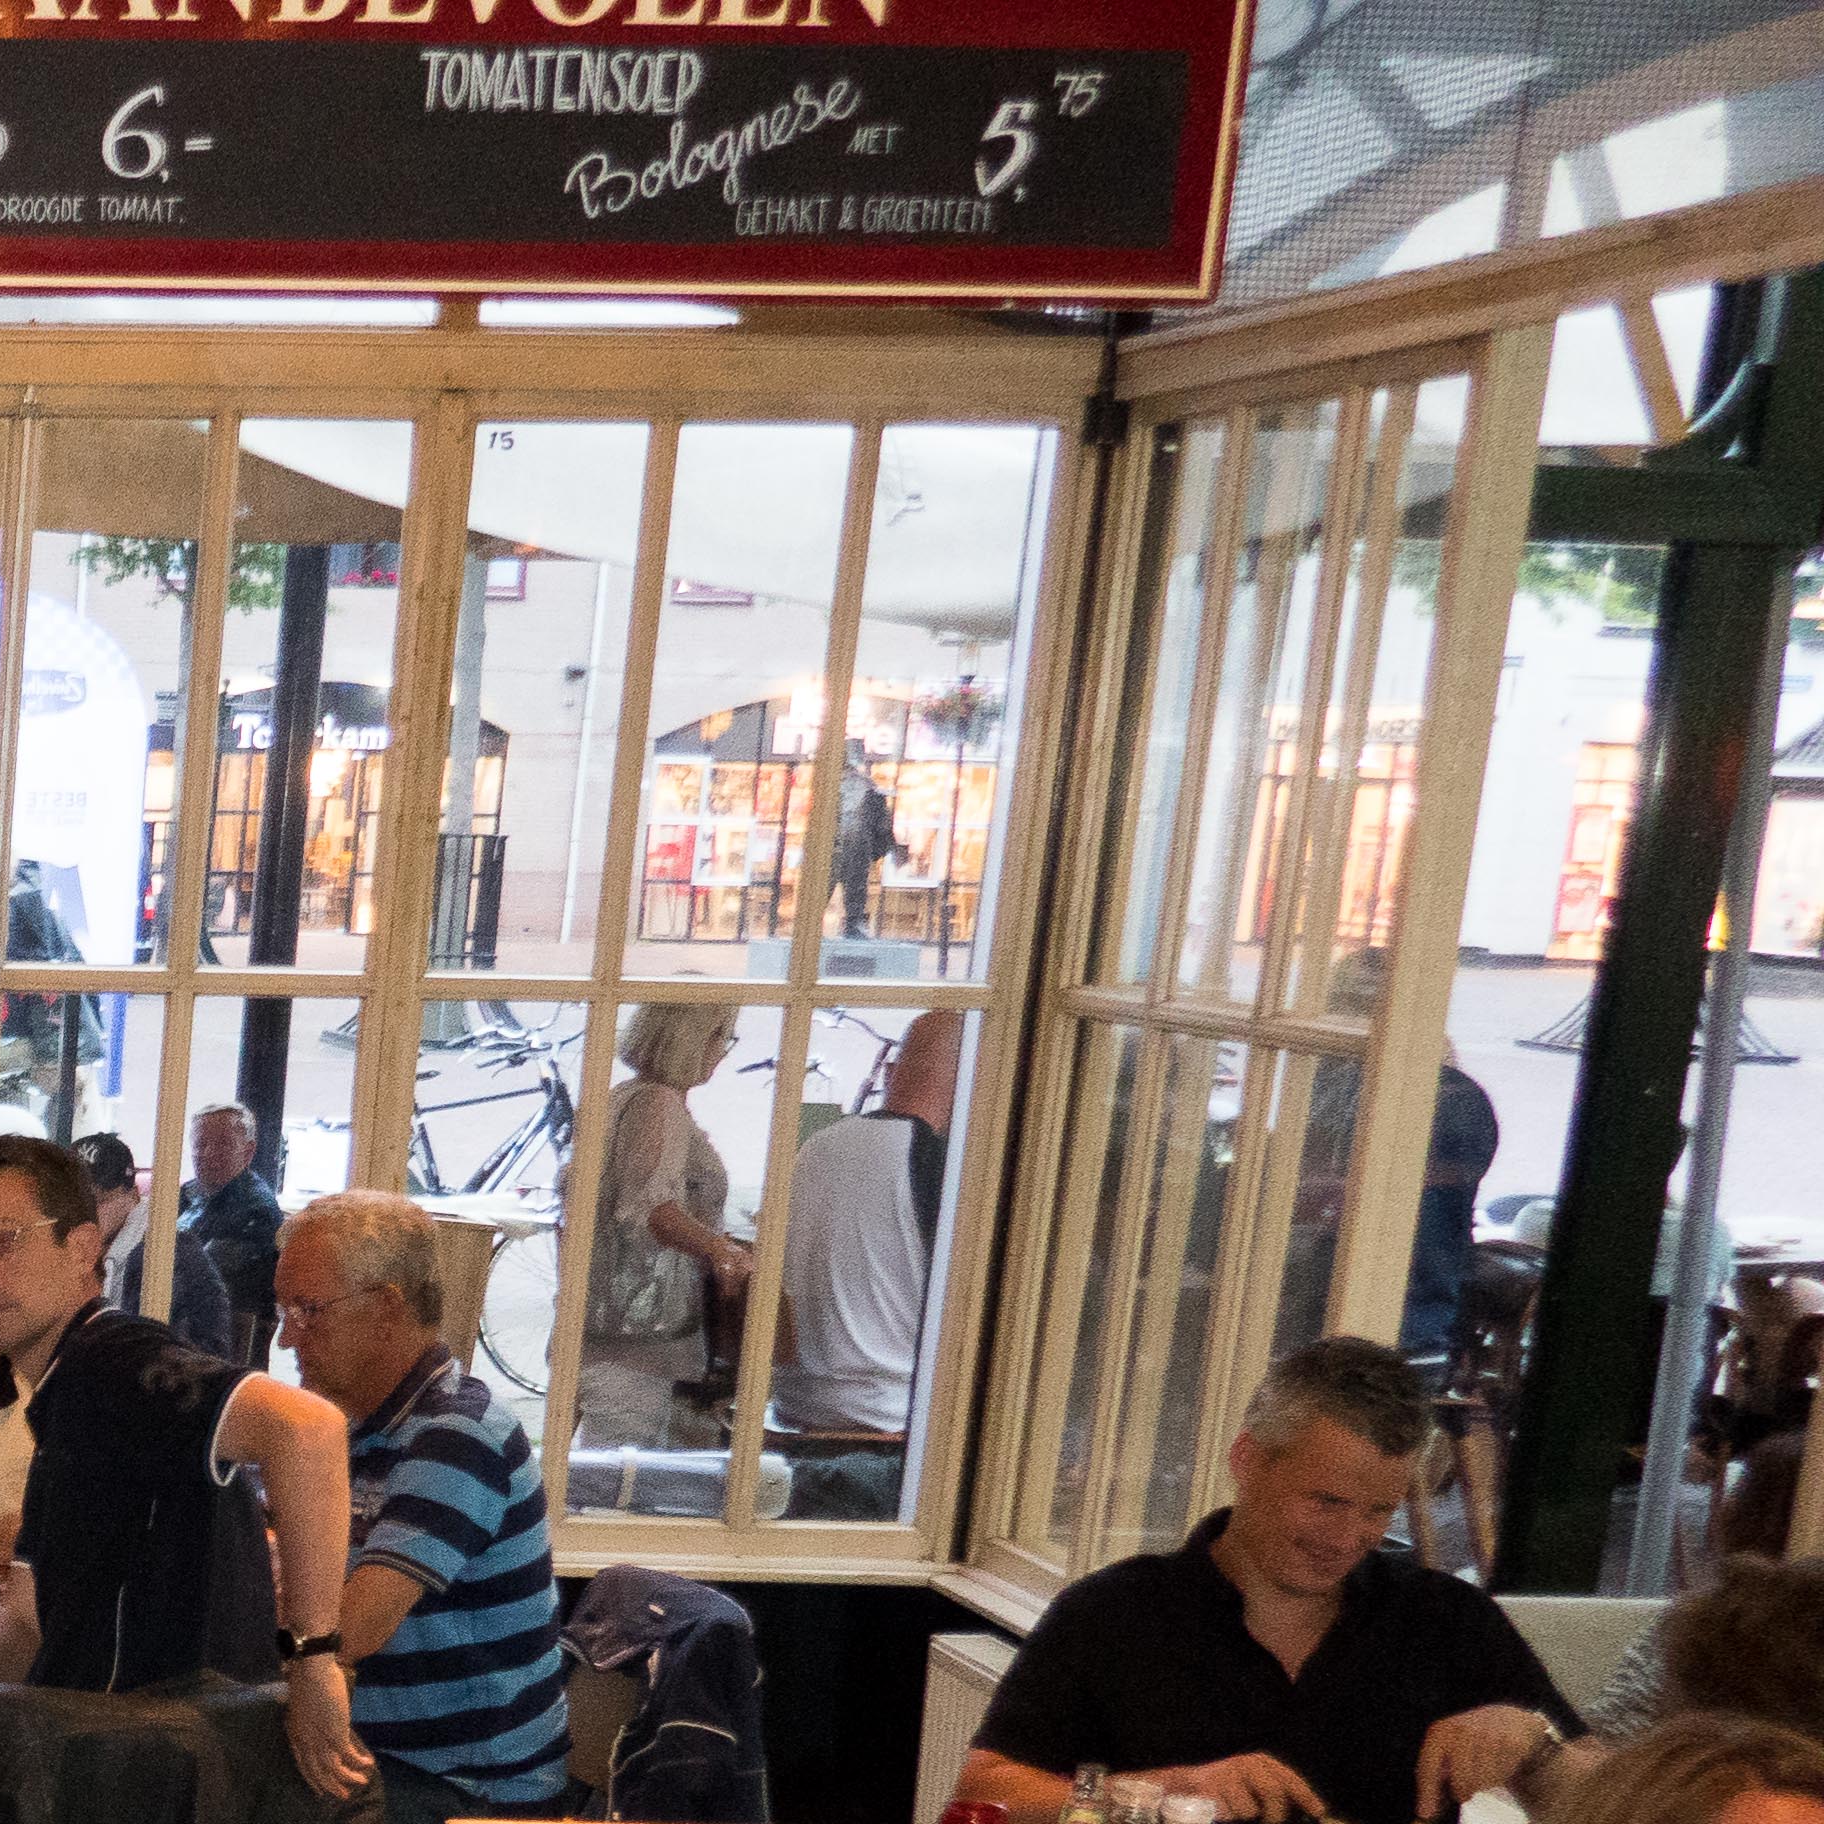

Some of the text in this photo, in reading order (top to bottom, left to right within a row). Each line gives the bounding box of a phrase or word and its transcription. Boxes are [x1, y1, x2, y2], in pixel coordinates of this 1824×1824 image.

[419, 49, 704, 114] TOMATENSOEP
[564, 77, 901, 220] Bolognese MET
[736, 199, 830, 236] GEHAKT
[839, 200, 854, 233] &
[488, 431, 515, 452] 15
